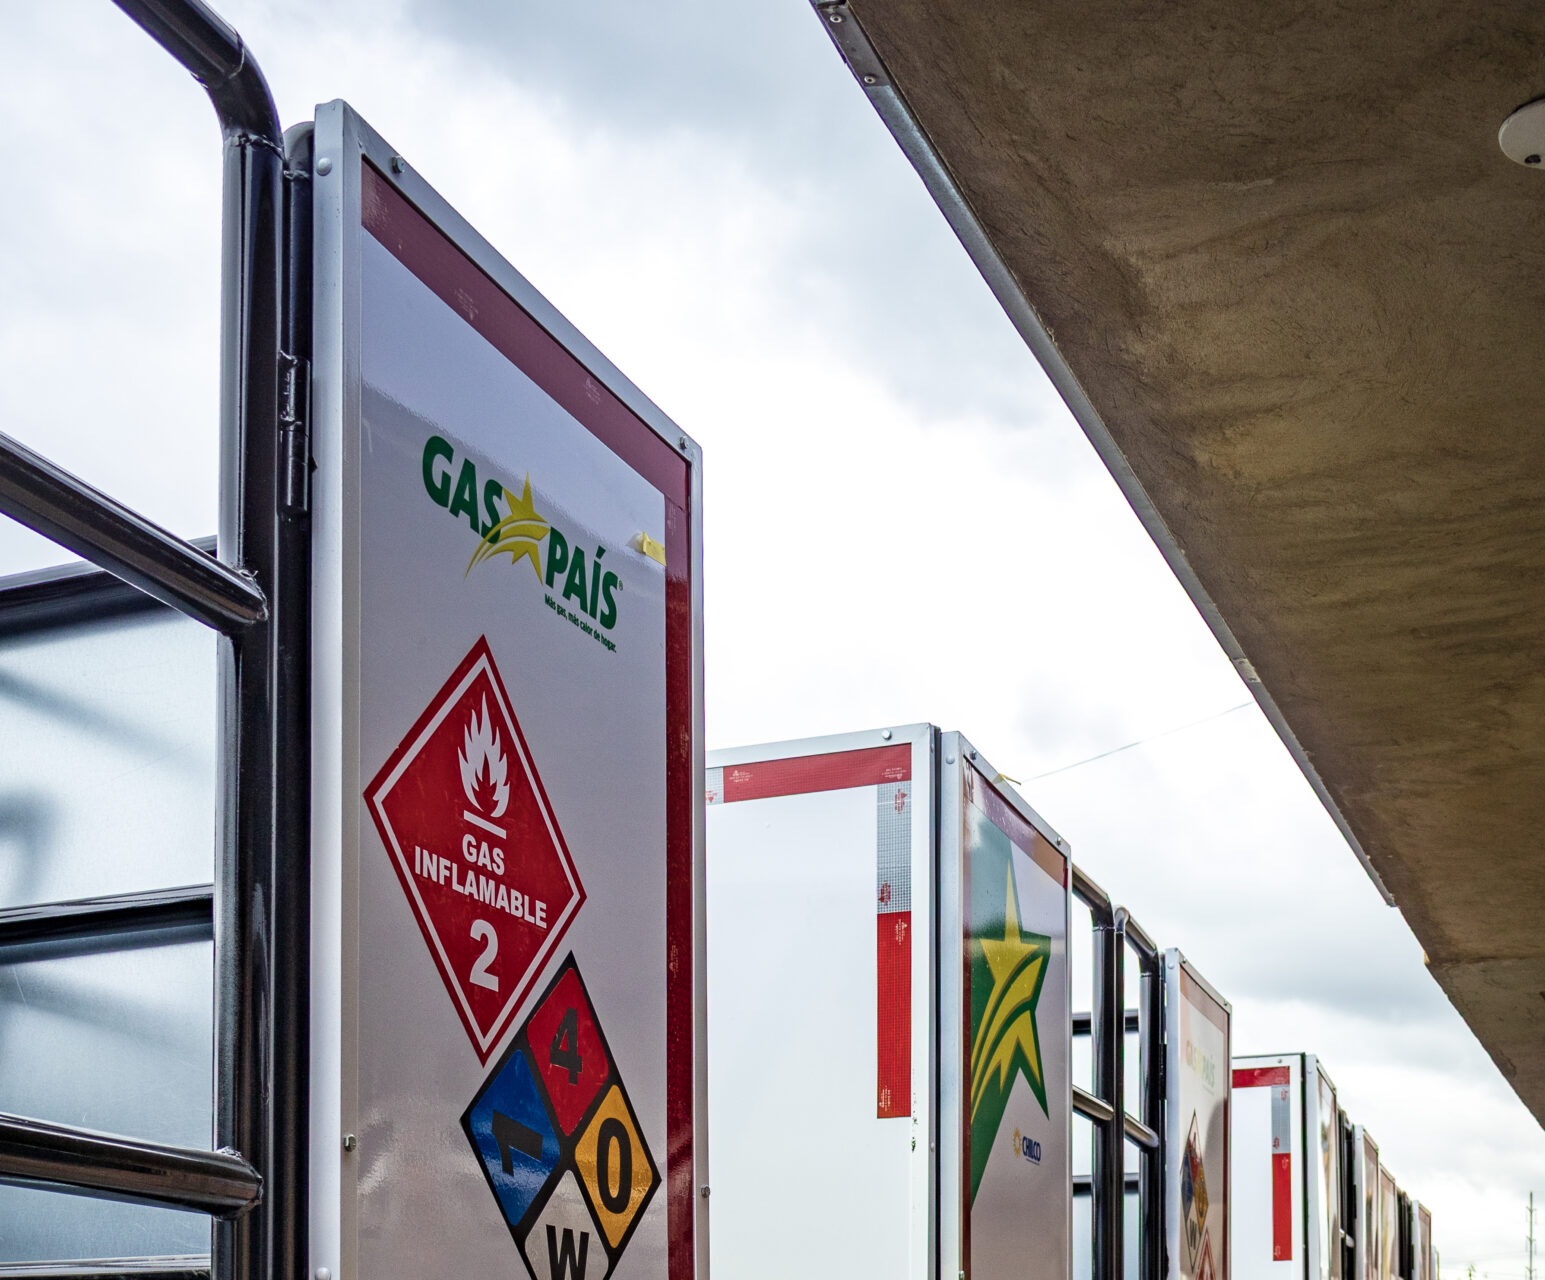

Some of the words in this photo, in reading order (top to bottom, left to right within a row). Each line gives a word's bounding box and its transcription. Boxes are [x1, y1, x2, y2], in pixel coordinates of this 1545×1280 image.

[422, 435, 503, 544] GAS
[545, 526, 618, 629] PAÍS
[414, 845, 547, 929] INFLAMABLE
[462, 834, 505, 875] GAS
[469, 918, 499, 992] 2
[549, 1006, 583, 1086] 4
